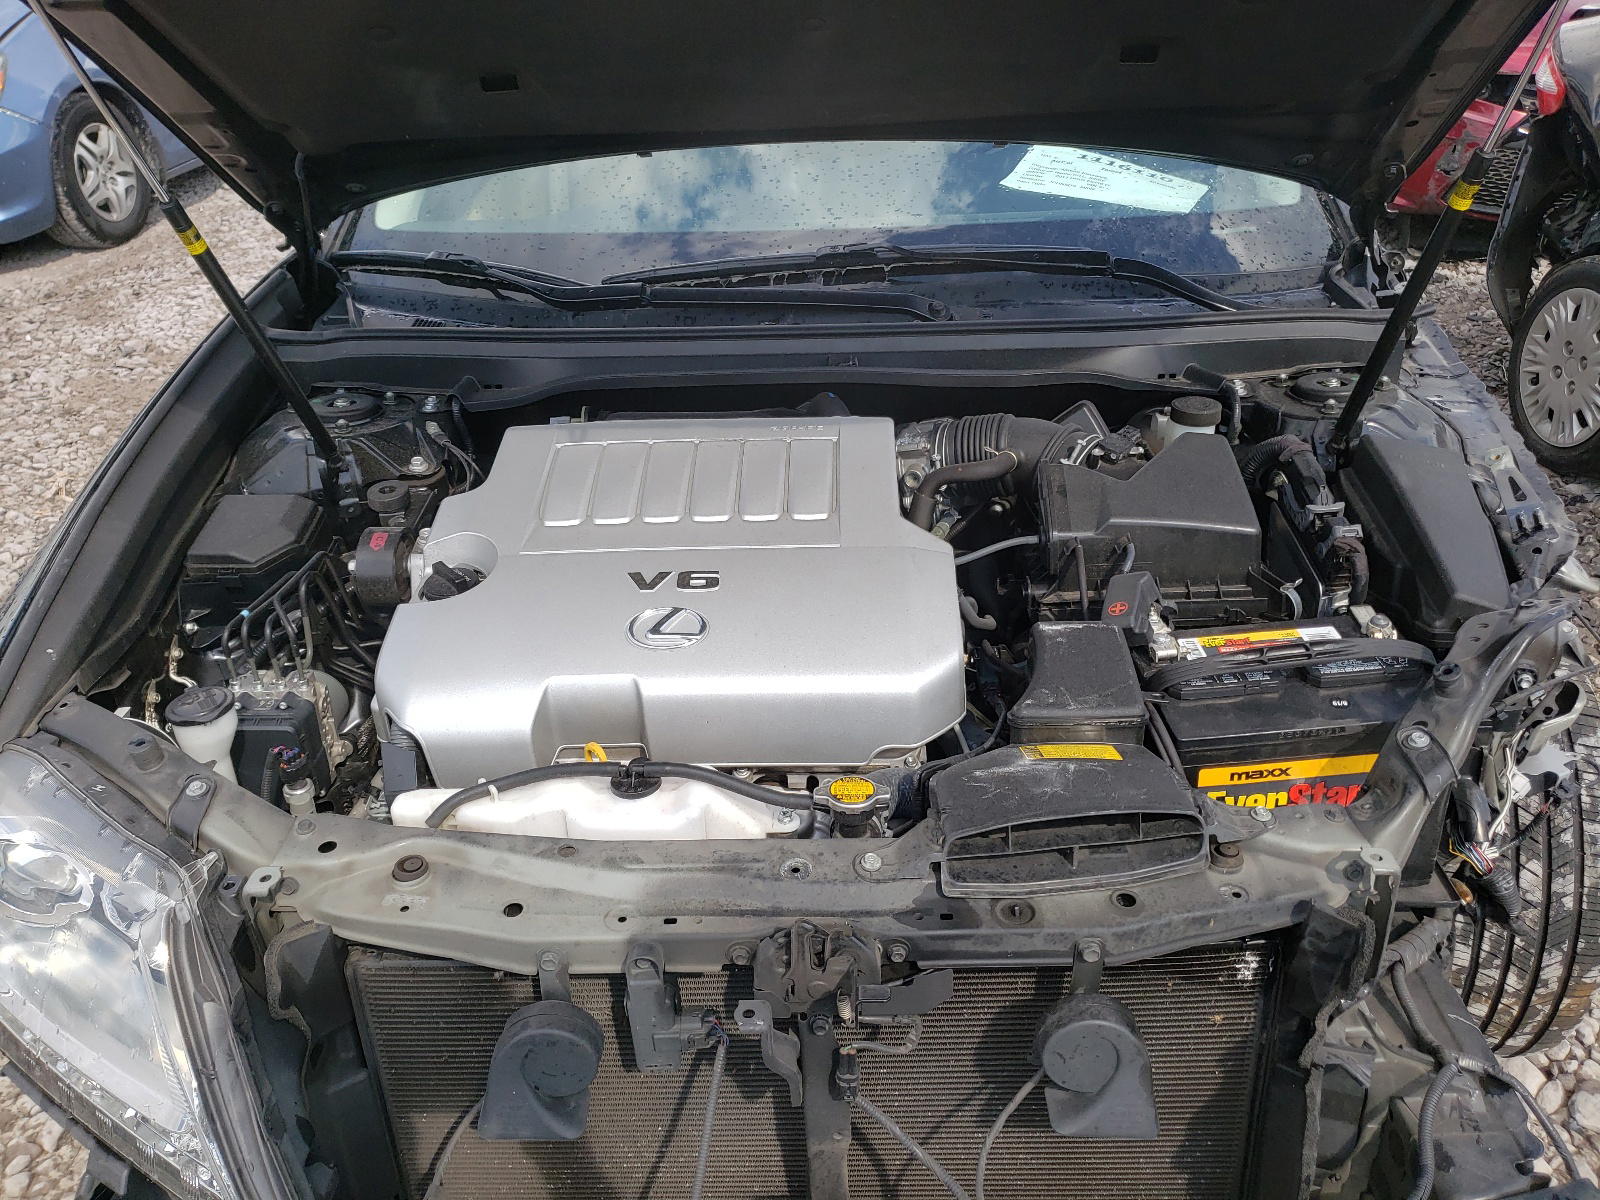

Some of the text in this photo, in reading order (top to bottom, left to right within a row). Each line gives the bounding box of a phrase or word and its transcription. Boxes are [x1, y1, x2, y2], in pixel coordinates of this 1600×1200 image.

[627, 570, 721, 593] V6
[1229, 766, 1293, 782] maxx
[1206, 781, 1362, 808] verStar
